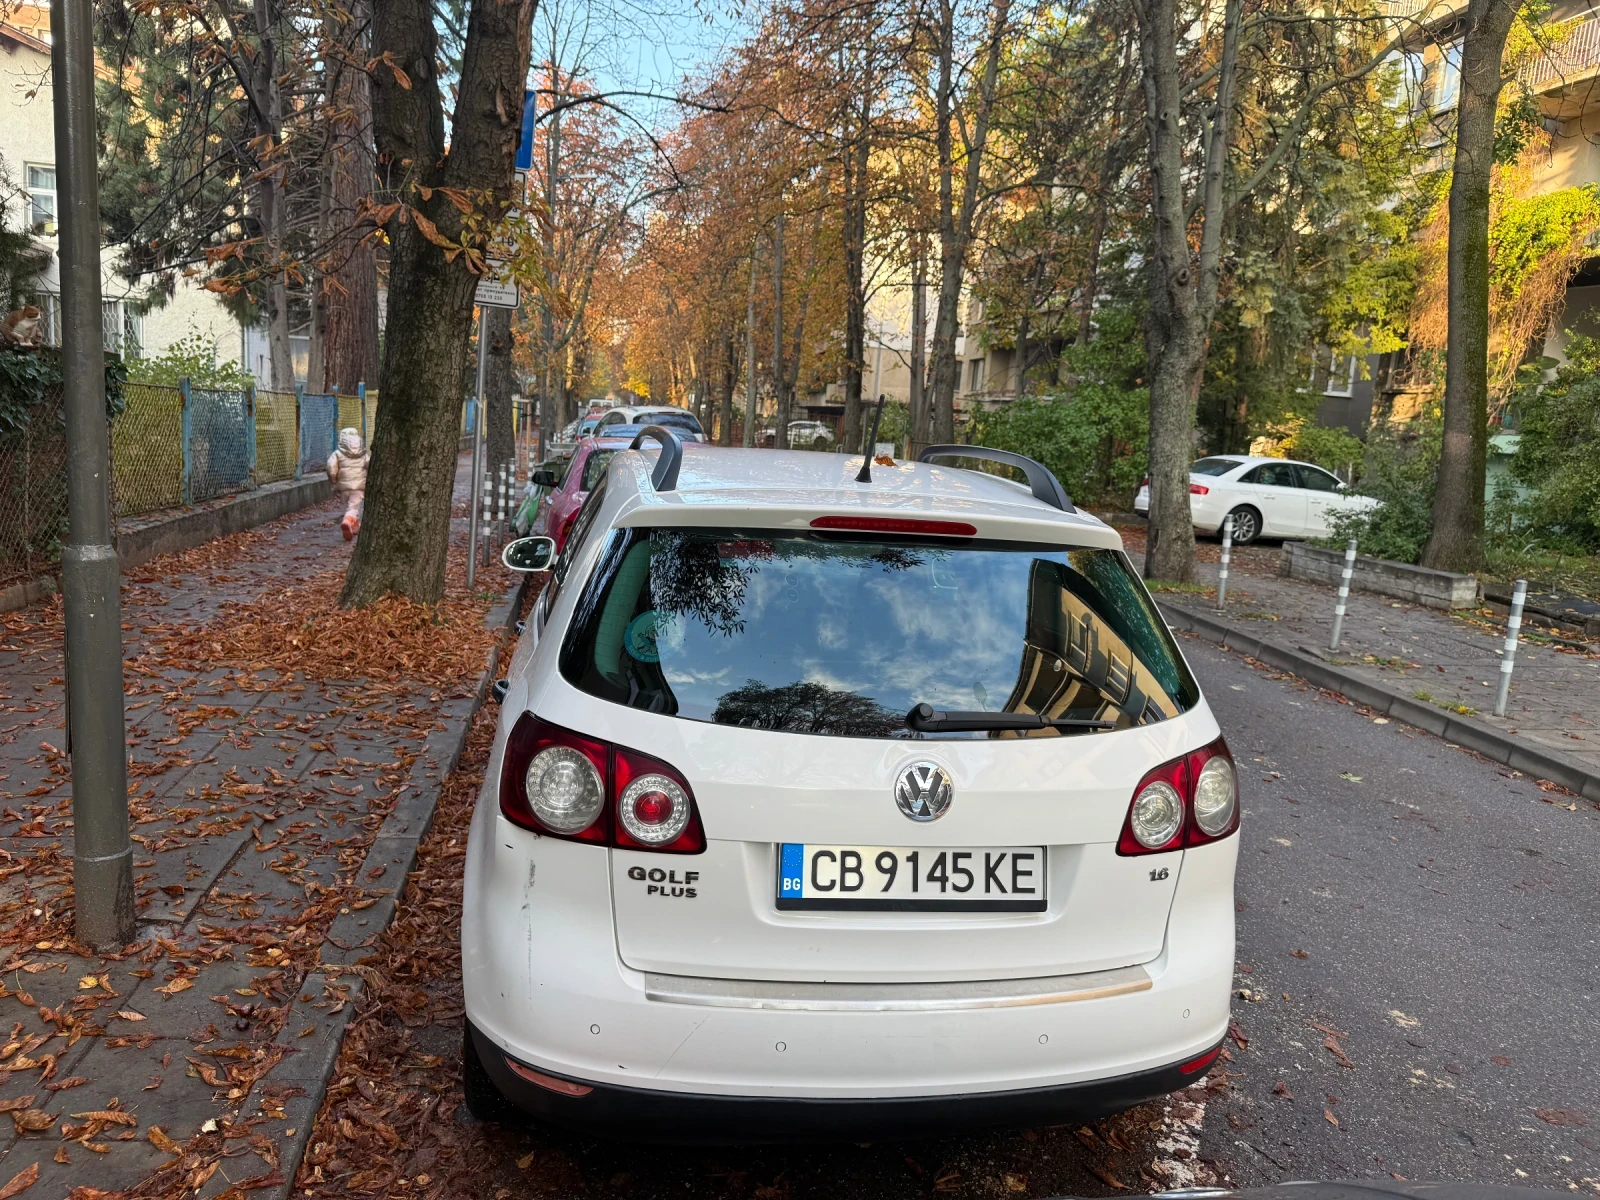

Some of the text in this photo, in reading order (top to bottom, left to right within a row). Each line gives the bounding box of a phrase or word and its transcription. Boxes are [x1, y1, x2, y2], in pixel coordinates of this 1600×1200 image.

[627, 866, 700, 885] GOLF
[810, 850, 1036, 894] CB 9145 KE
[647, 884, 698, 899] PLUS
[783, 877, 801, 891] BG
